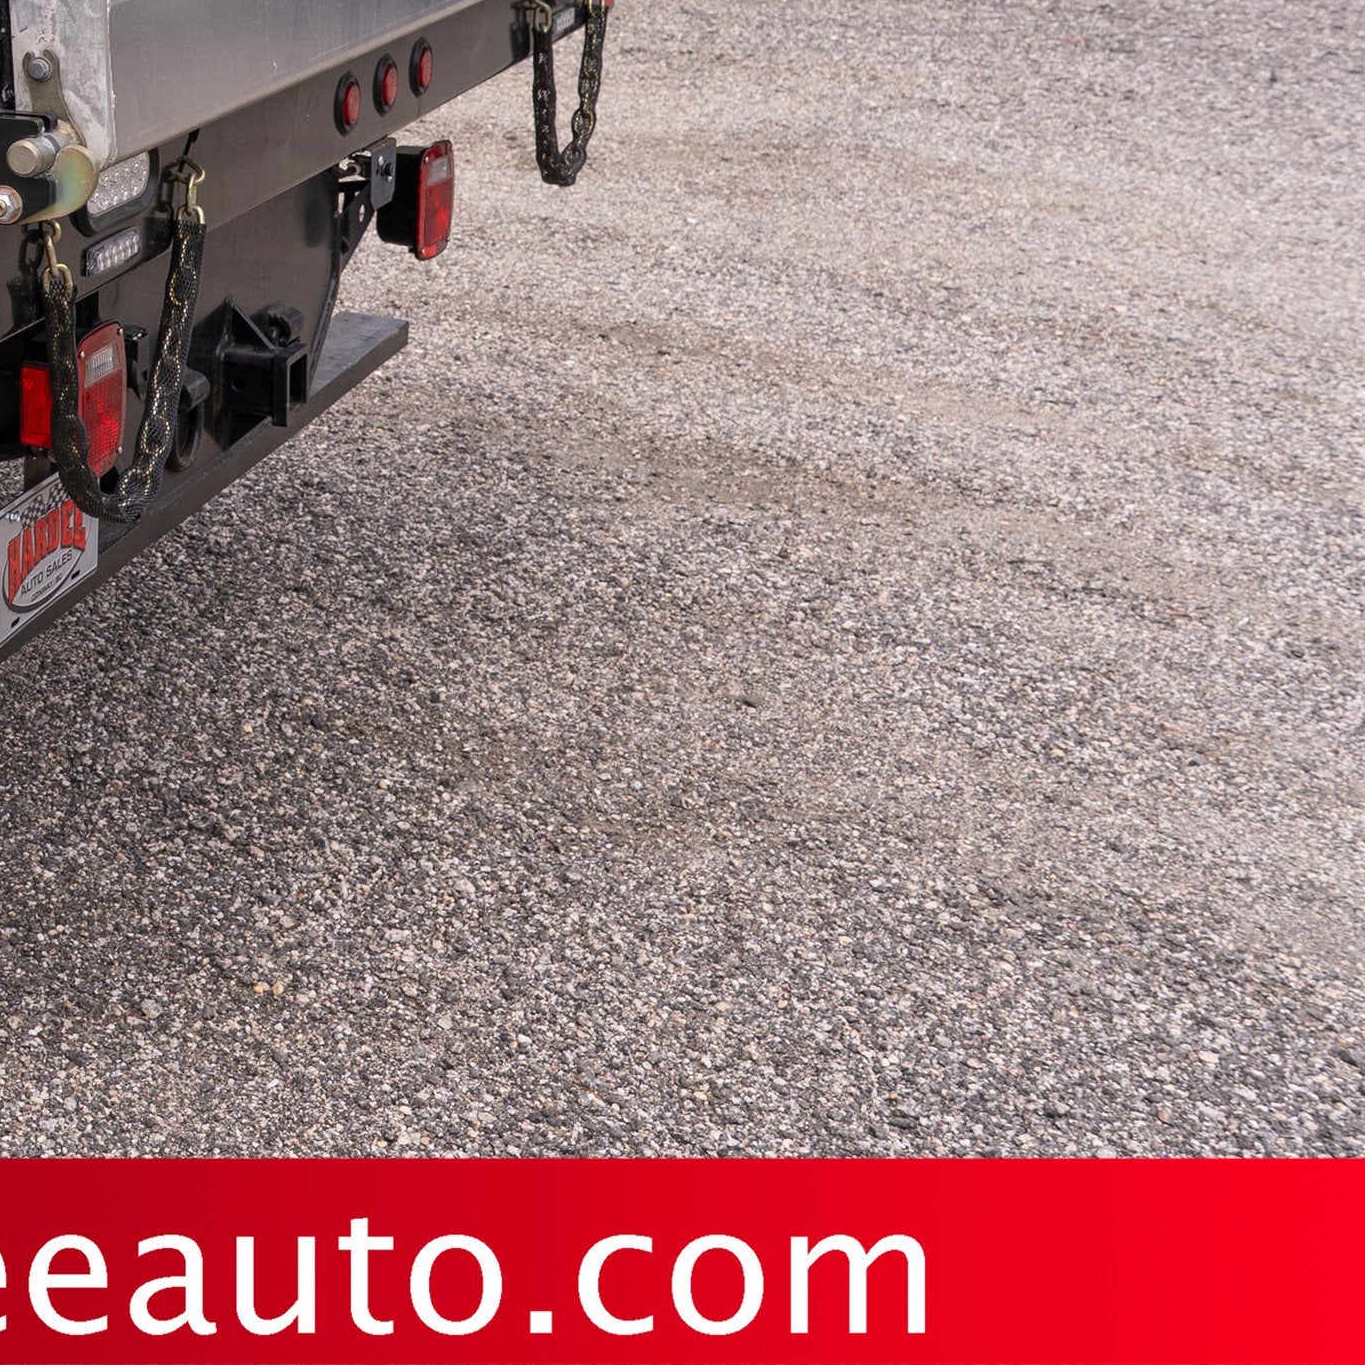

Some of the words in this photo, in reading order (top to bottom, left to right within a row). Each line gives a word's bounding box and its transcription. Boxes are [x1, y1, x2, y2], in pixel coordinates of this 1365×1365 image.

[7, 498, 87, 607] HARDEE
[19, 570, 44, 597] AUTO
[46, 549, 73, 579] SALES
[31, 579, 54, 602] CONWAY
